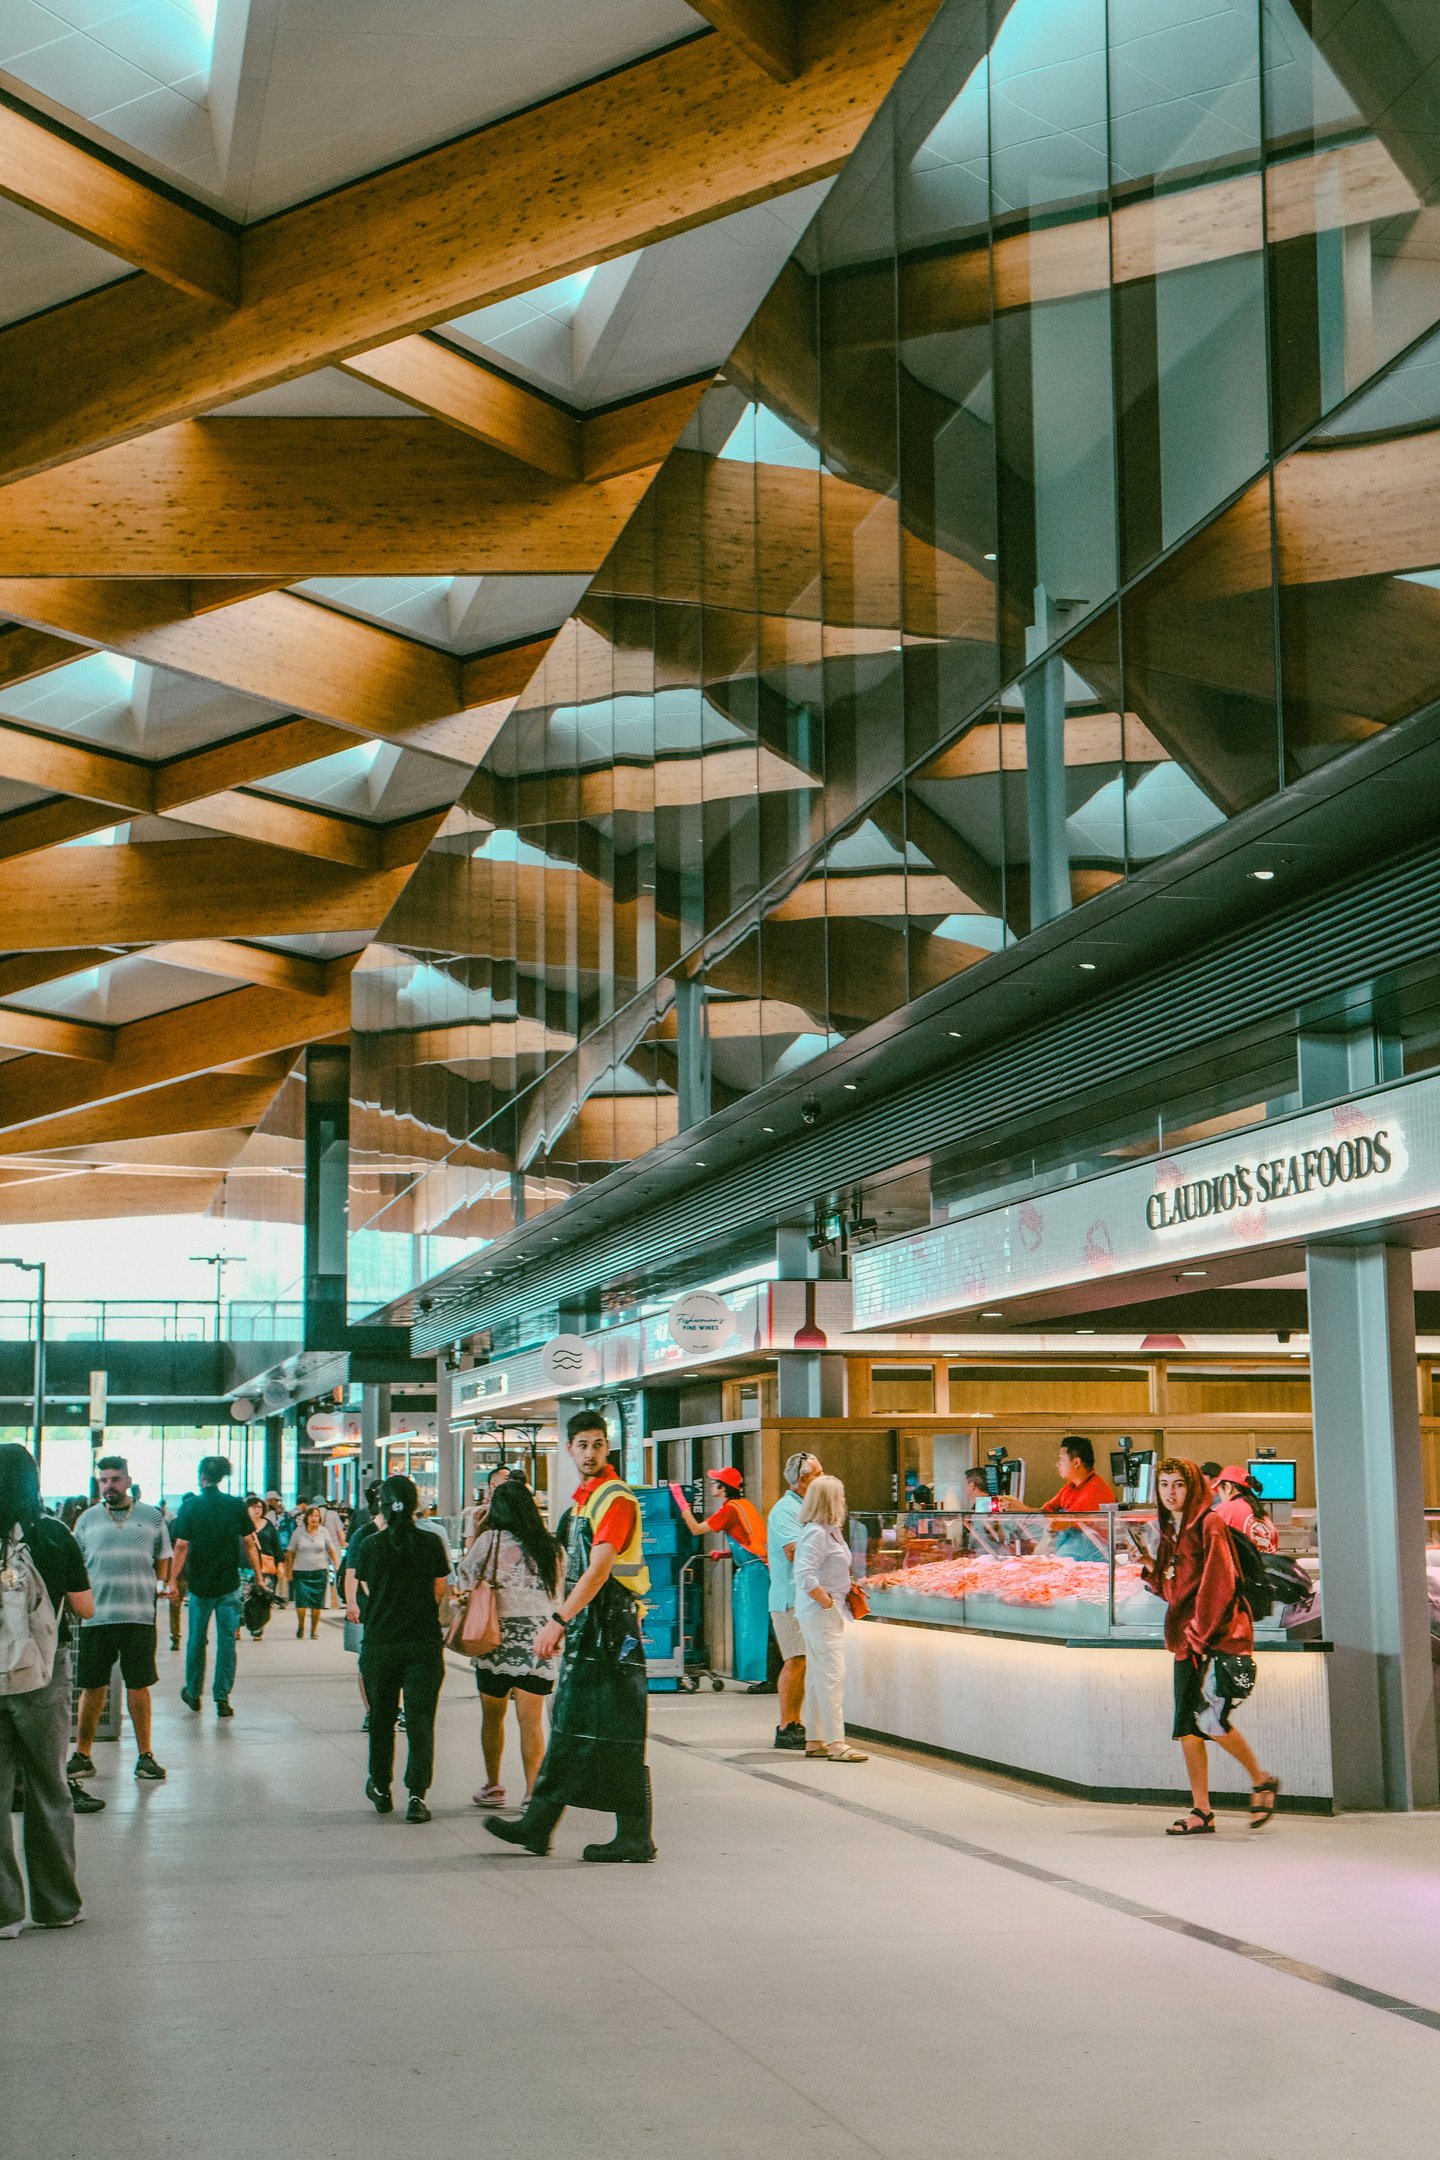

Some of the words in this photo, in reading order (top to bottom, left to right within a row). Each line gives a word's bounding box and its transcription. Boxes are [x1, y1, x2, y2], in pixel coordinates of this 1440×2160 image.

[1146, 1164, 1253, 1231] CLAUDIO'S
[1256, 1130, 1392, 1203] SEAFOODS
[693, 1478, 703, 1514] WINE
